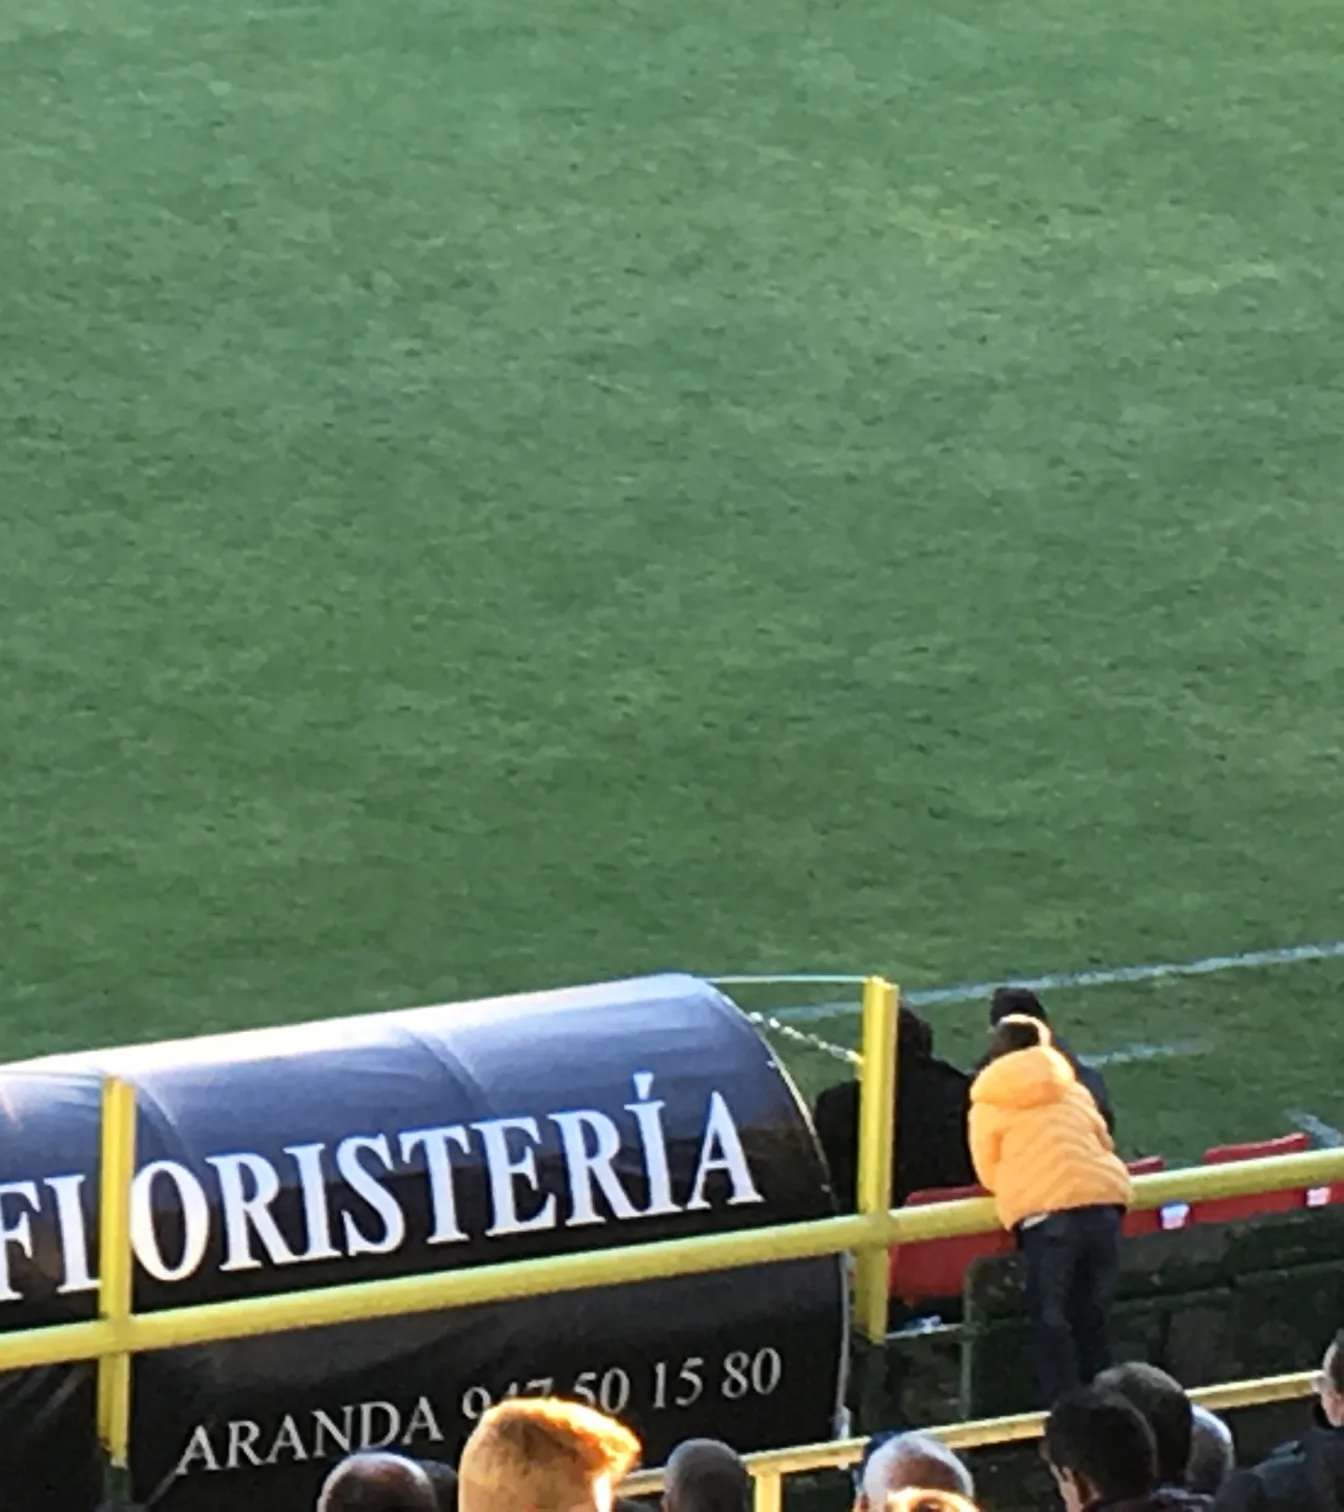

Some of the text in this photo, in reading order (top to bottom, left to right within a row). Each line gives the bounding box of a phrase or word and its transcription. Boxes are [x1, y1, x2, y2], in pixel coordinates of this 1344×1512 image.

[174, 1395, 445, 1476] ARANDA
[574, 1367, 631, 1415] 50
[652, 1356, 704, 1409] 15
[721, 1347, 782, 1400] 80
